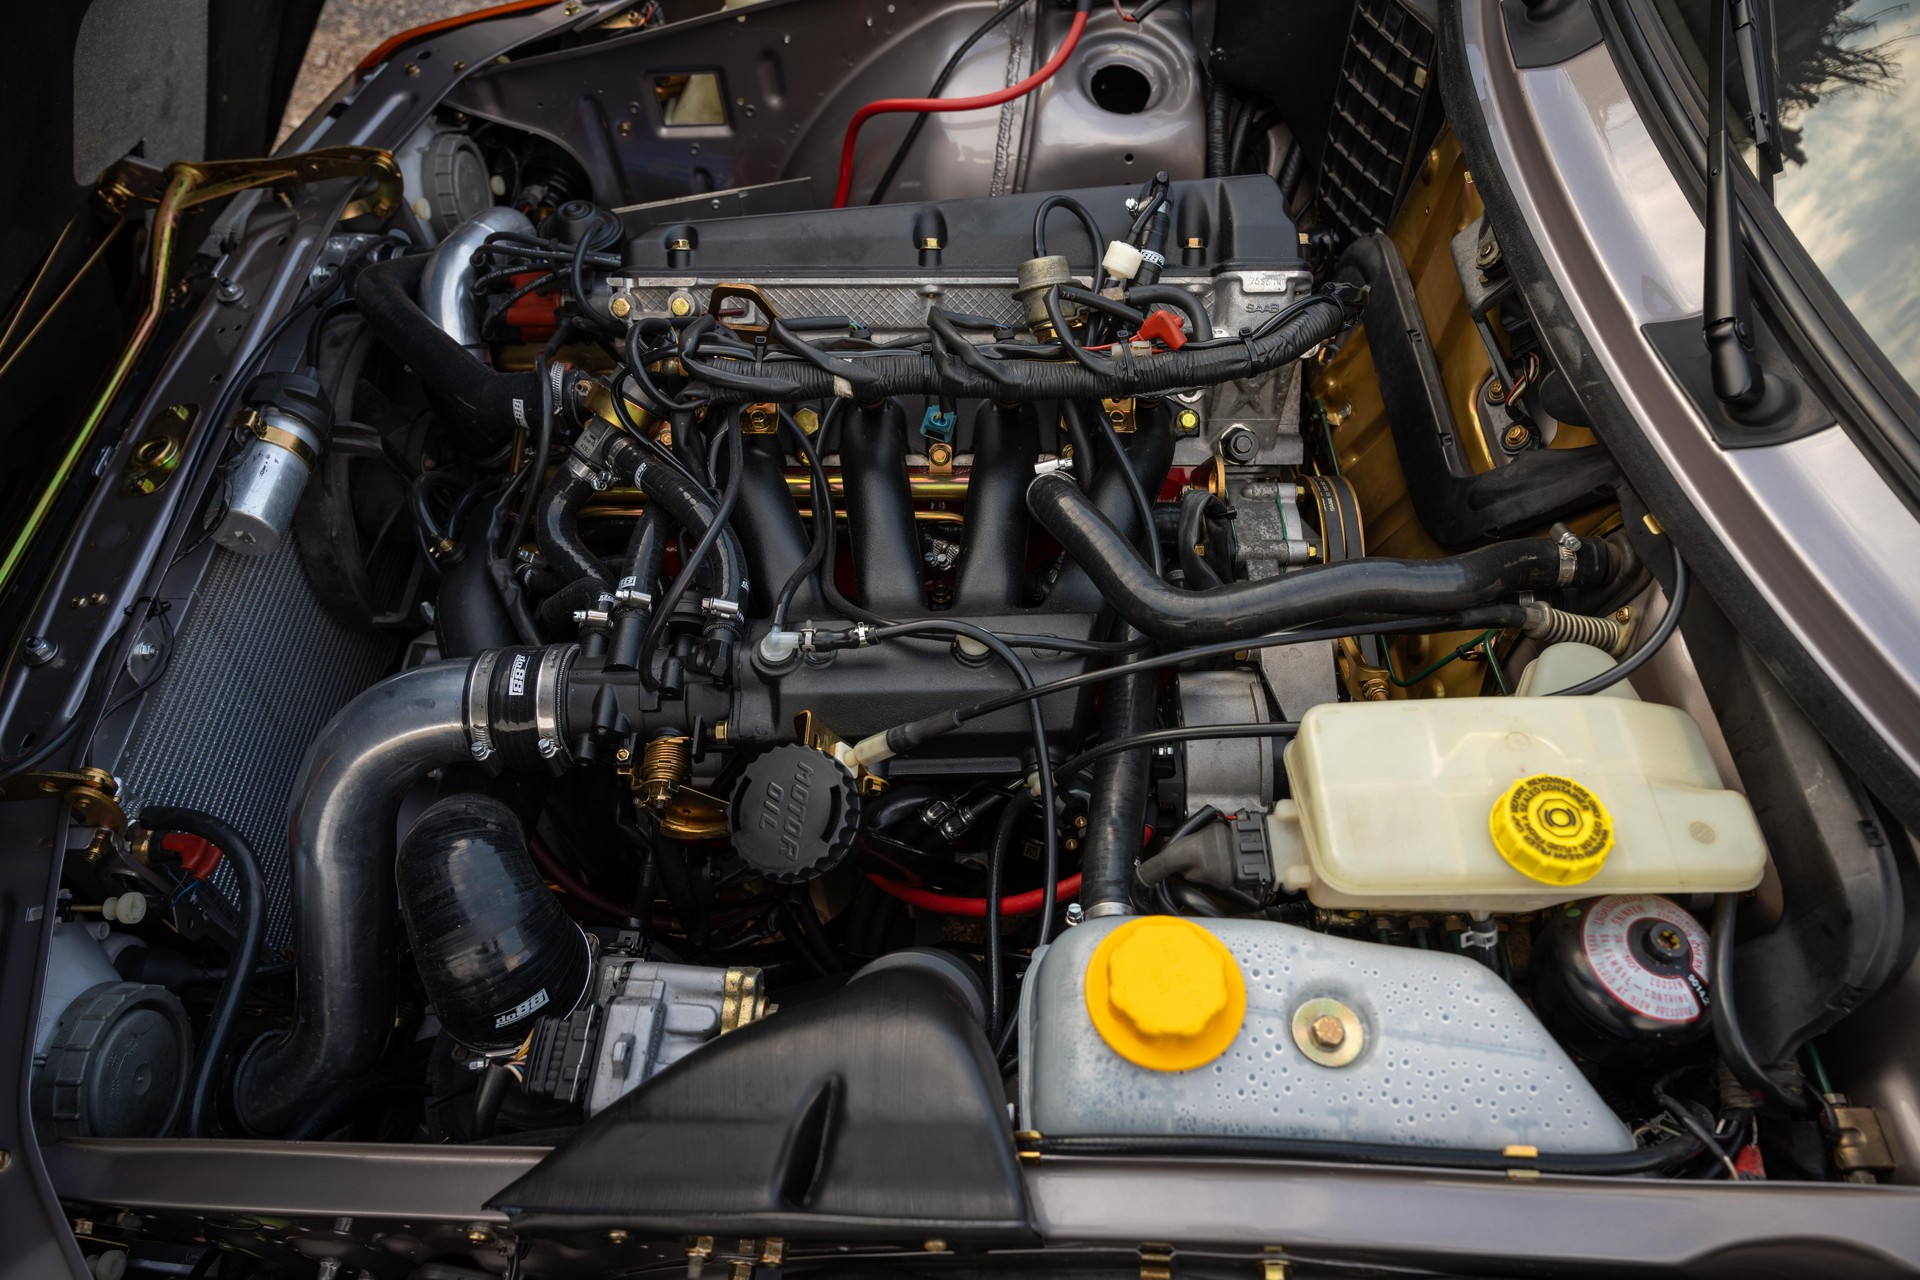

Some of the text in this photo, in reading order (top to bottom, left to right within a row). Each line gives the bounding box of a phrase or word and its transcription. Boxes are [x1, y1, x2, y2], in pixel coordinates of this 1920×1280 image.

[1246, 303, 1279, 313] SAAB
[512, 655, 526, 693] do88
[1510, 785, 1526, 813] BEFORE
[1526, 776, 1571, 787] REMOVING
[1520, 786, 1541, 813] SEALED
[1541, 784, 1589, 811] CONTAINER
[1573, 785, 1590, 798] USE
[759, 781, 785, 830] OIL
[778, 760, 815, 862] MOTOR
[1589, 799, 1601, 819] ONLY
[1644, 988, 1690, 1004] CONTAINS
[1649, 977, 1684, 990] LOOSEN
[496, 992, 545, 1024] do88
[1655, 1006, 1694, 1018] PRESSURE
